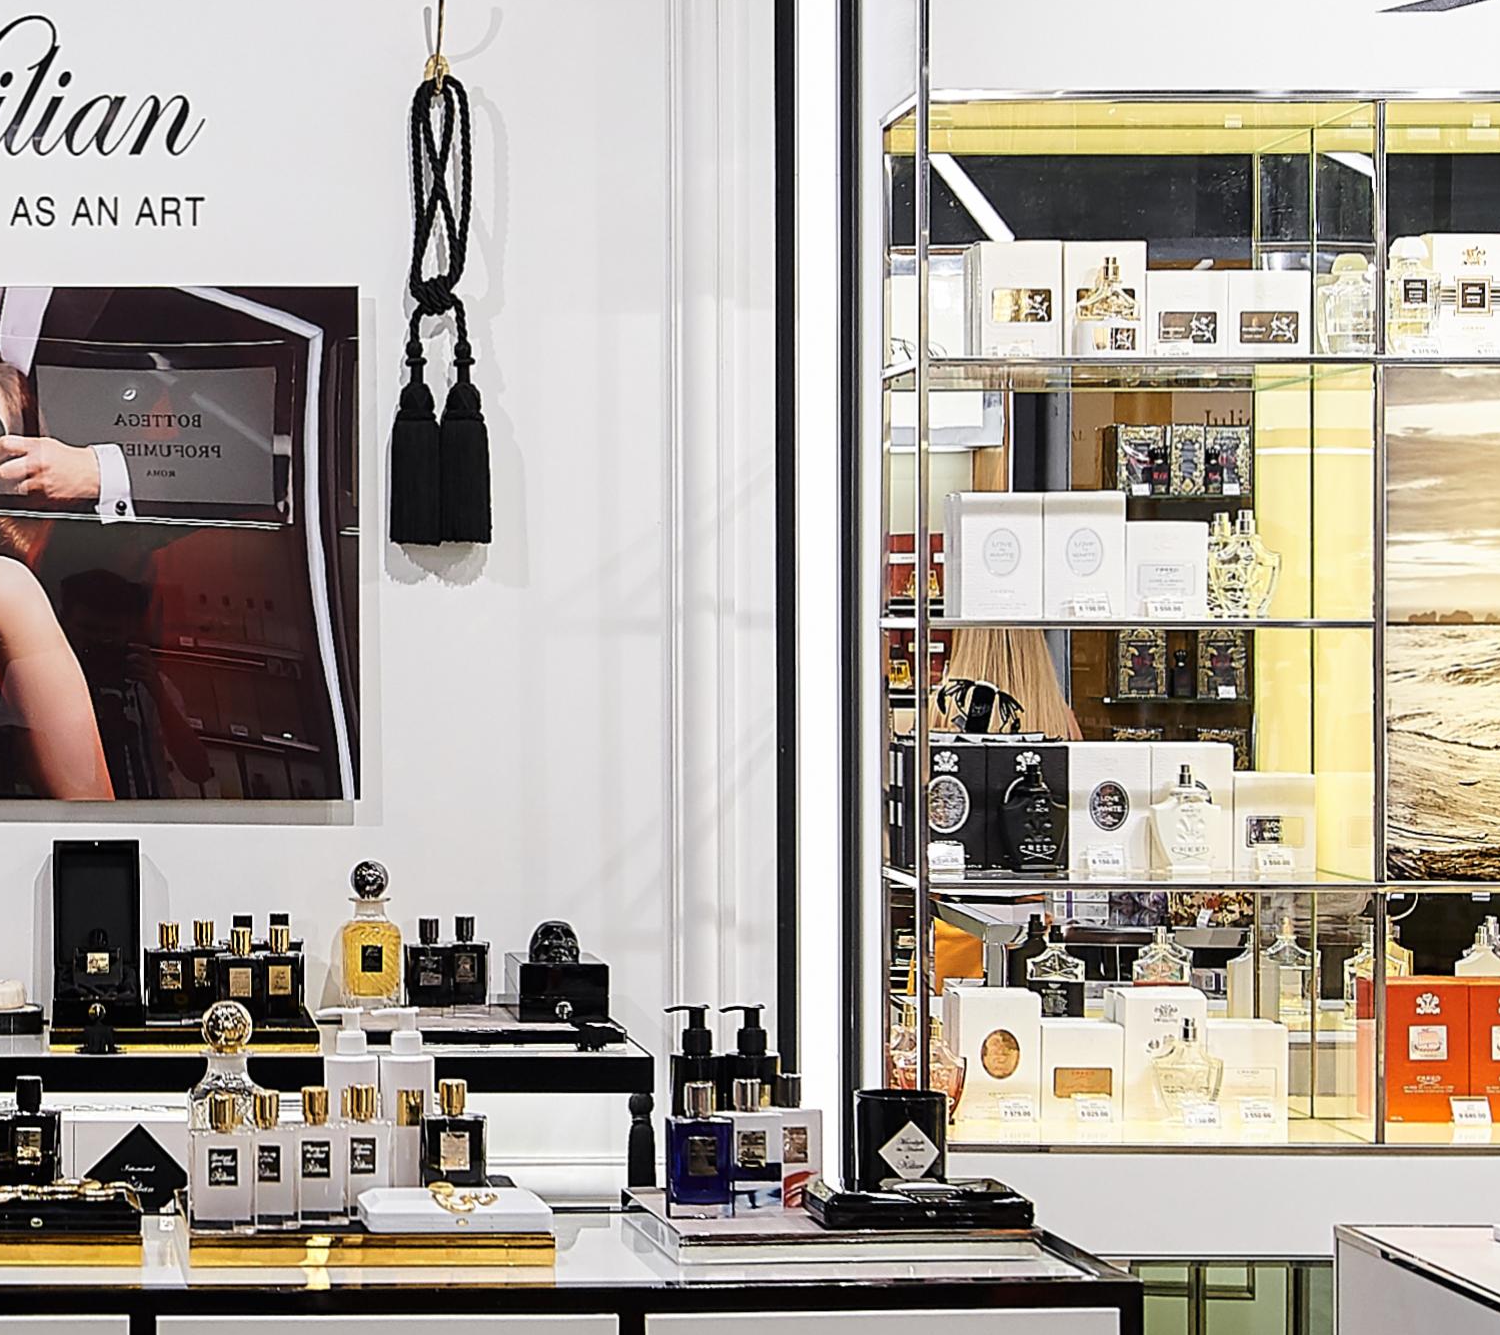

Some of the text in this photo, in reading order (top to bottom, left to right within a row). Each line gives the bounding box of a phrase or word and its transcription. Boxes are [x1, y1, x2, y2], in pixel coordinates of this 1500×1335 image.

[9, 195, 57, 228] AS
[71, 195, 120, 228] AN
[134, 195, 207, 228] ART
